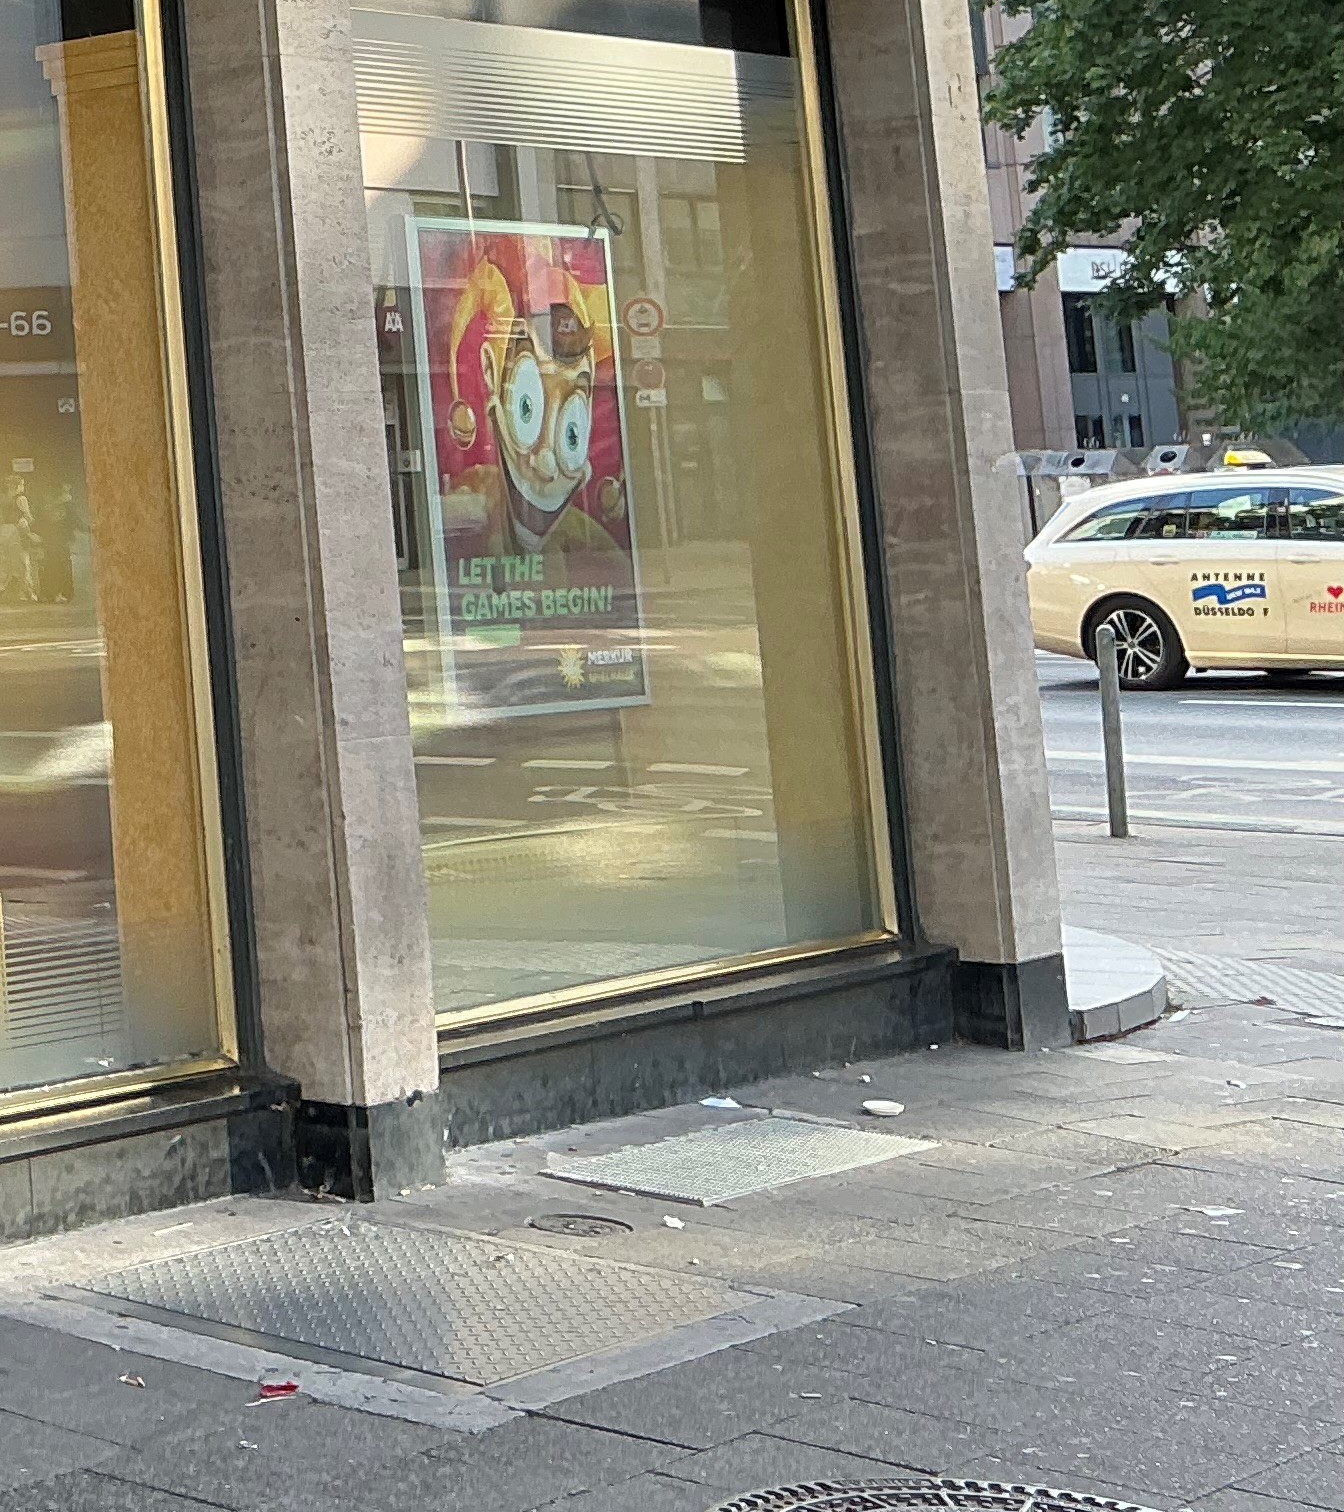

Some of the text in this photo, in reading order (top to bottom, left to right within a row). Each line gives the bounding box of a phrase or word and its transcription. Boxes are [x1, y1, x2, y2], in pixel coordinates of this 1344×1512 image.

[459, 553, 543, 585] LET THE
[462, 584, 614, 621] GAMES BEGIN!
